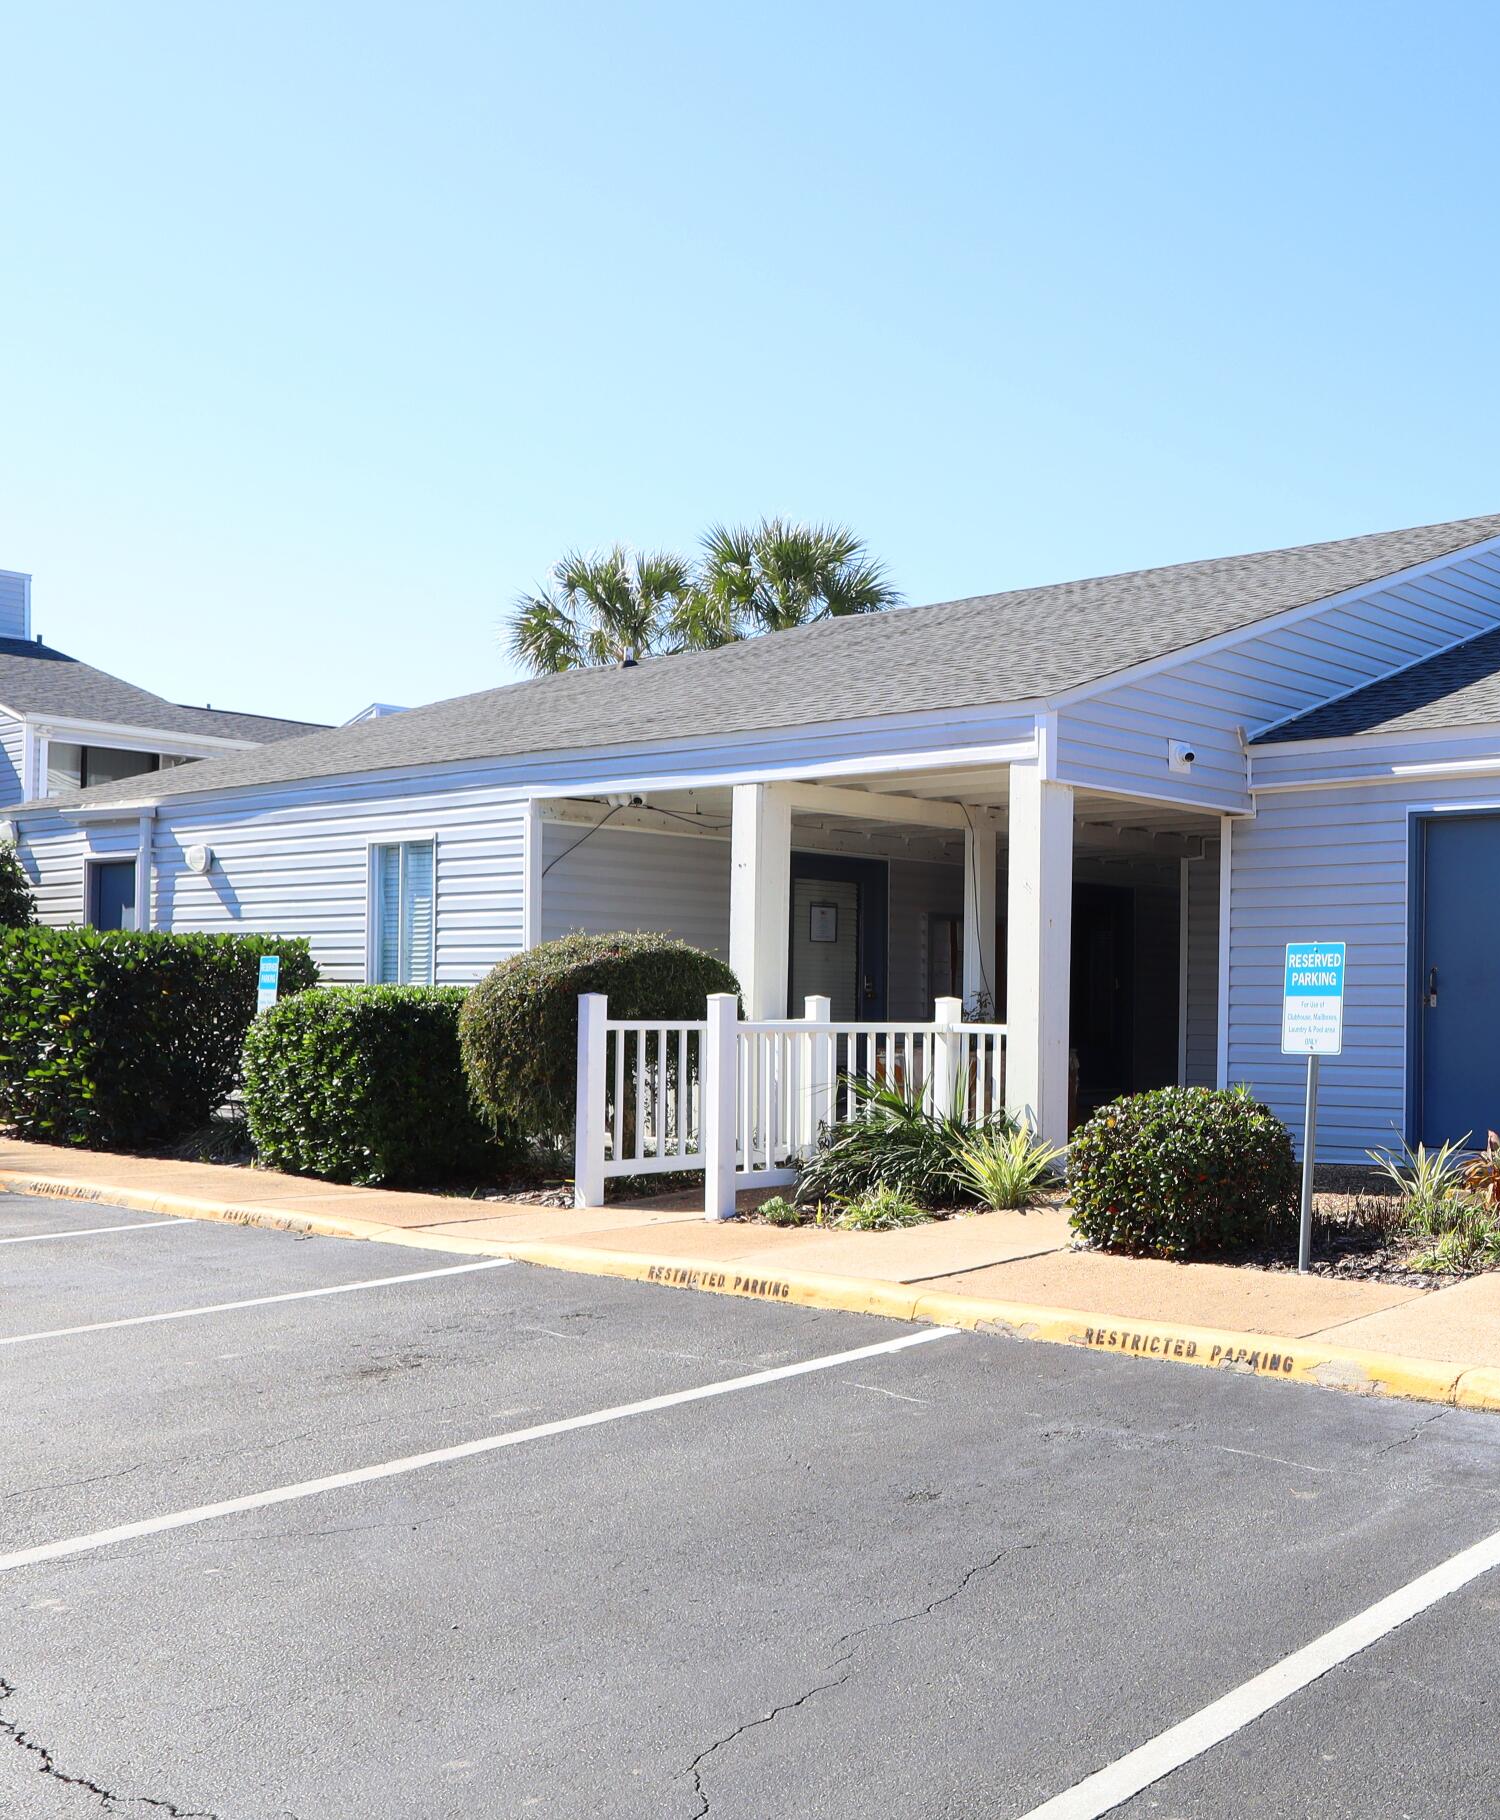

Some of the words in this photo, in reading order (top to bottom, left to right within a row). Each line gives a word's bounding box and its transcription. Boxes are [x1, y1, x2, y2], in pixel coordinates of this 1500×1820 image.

[1288, 953, 1341, 968] RESERVED
[1291, 971, 1337, 986] PARKING
[647, 1265, 726, 1288] RESTRICTED
[733, 1276, 790, 1298] PARKING
[1085, 1327, 1198, 1358] RESTRICTED
[1210, 1344, 1295, 1373] PARKING
